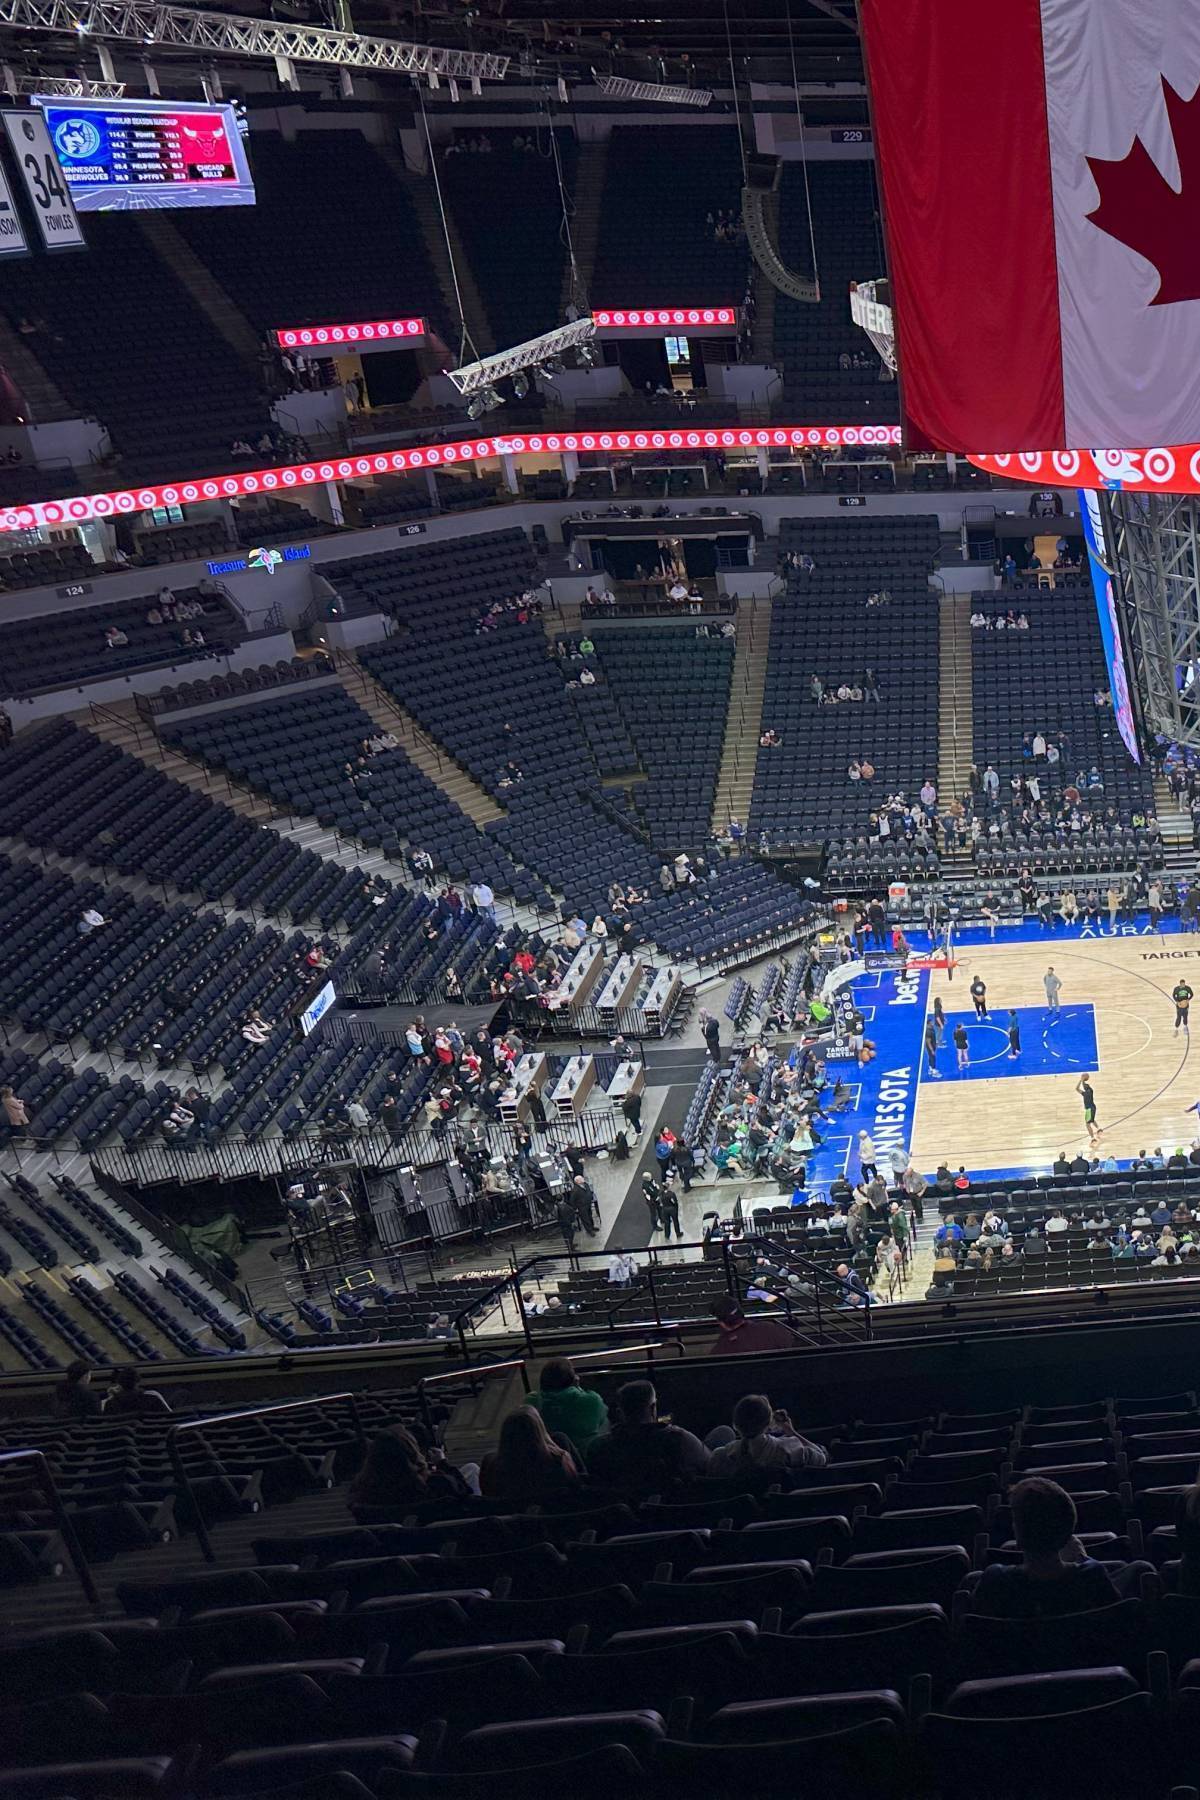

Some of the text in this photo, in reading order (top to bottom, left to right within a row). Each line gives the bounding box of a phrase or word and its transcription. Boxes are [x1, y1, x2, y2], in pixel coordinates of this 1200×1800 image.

[843, 131, 863, 142] 229
[24, 153, 67, 209] 34
[45, 214, 74, 231] FOWLES
[206, 543, 311, 575] Treasure Island
[66, 585, 85, 597] 124
